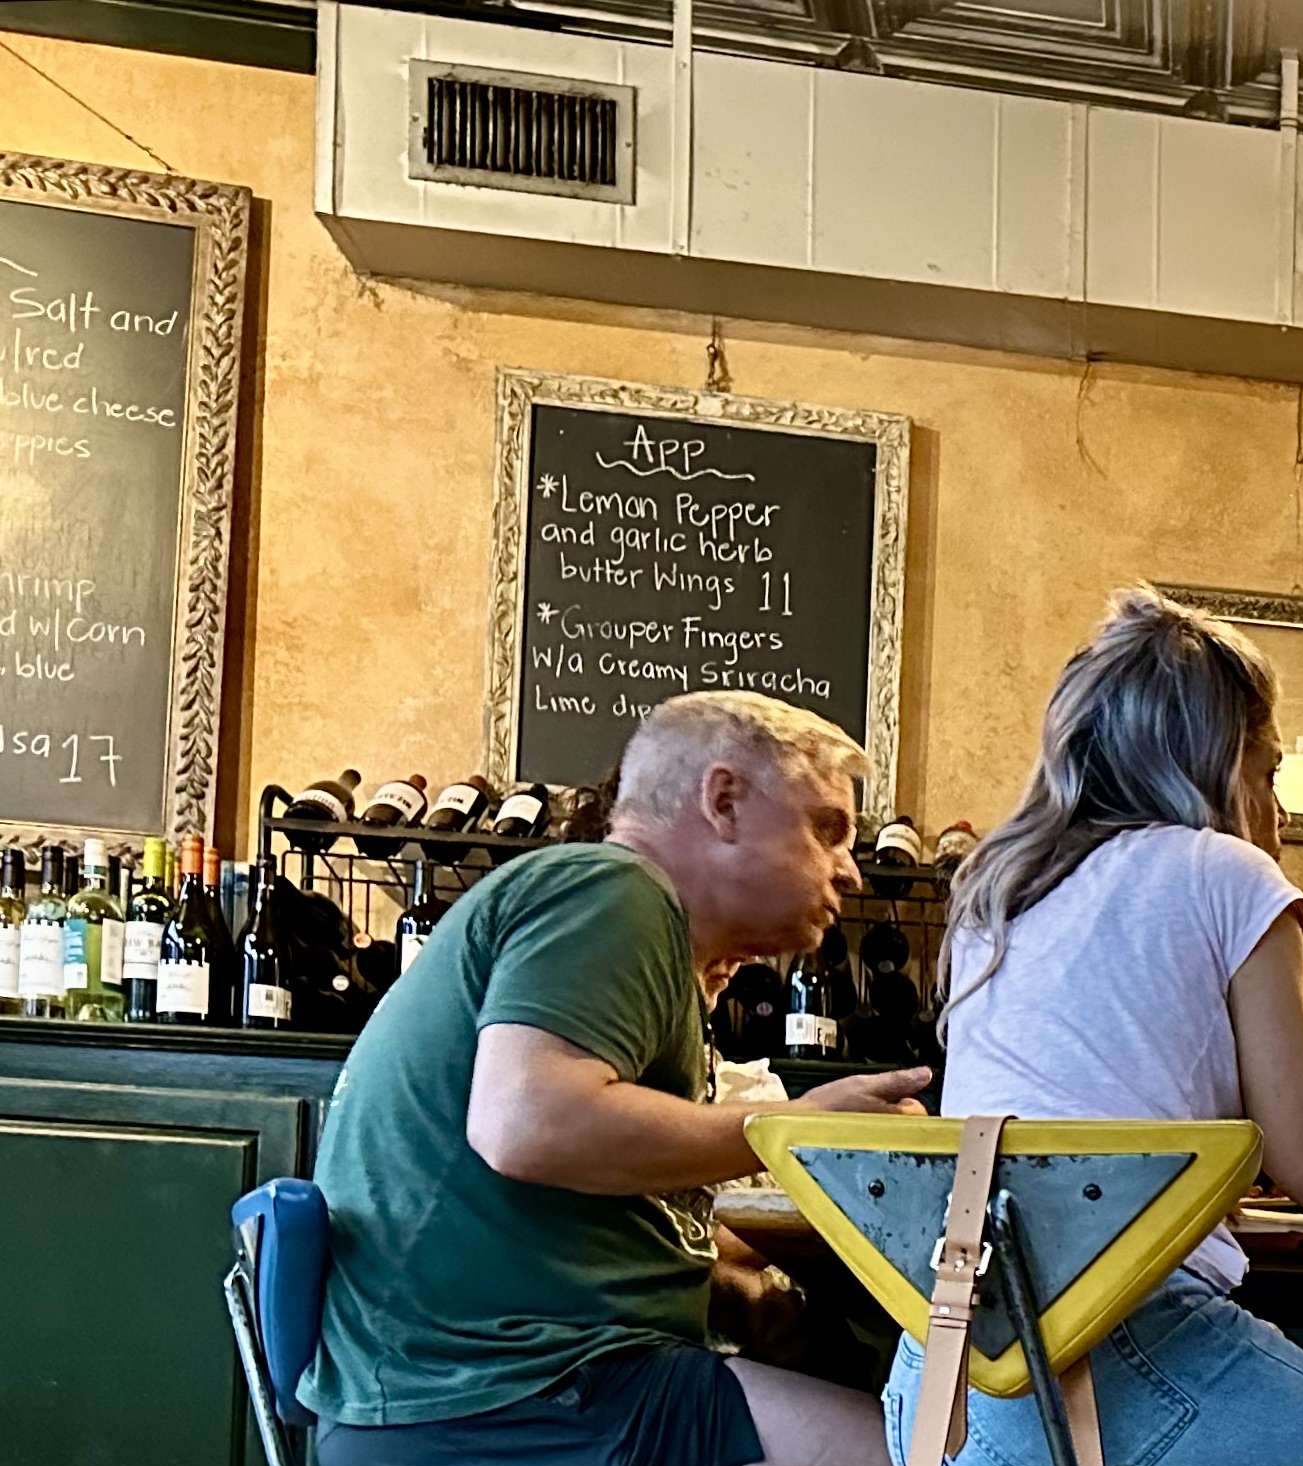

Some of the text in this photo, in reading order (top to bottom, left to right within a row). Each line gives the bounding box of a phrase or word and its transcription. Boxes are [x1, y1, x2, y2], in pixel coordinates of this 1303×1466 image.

[10, 286, 178, 336] Salt and
[0, 377, 176, 427] blue cheese
[624, 425, 705, 474] App
[540, 522, 773, 566] and garlic herb
[559, 551, 644, 590] butter
[757, 571, 793, 617] 11
[560, 604, 784, 666] Grouper Fingers
[15, 651, 75, 681] blue
[700, 661, 832, 699] Sriracha
[534, 684, 597, 715] Lime
[59, 733, 123, 788] 17
